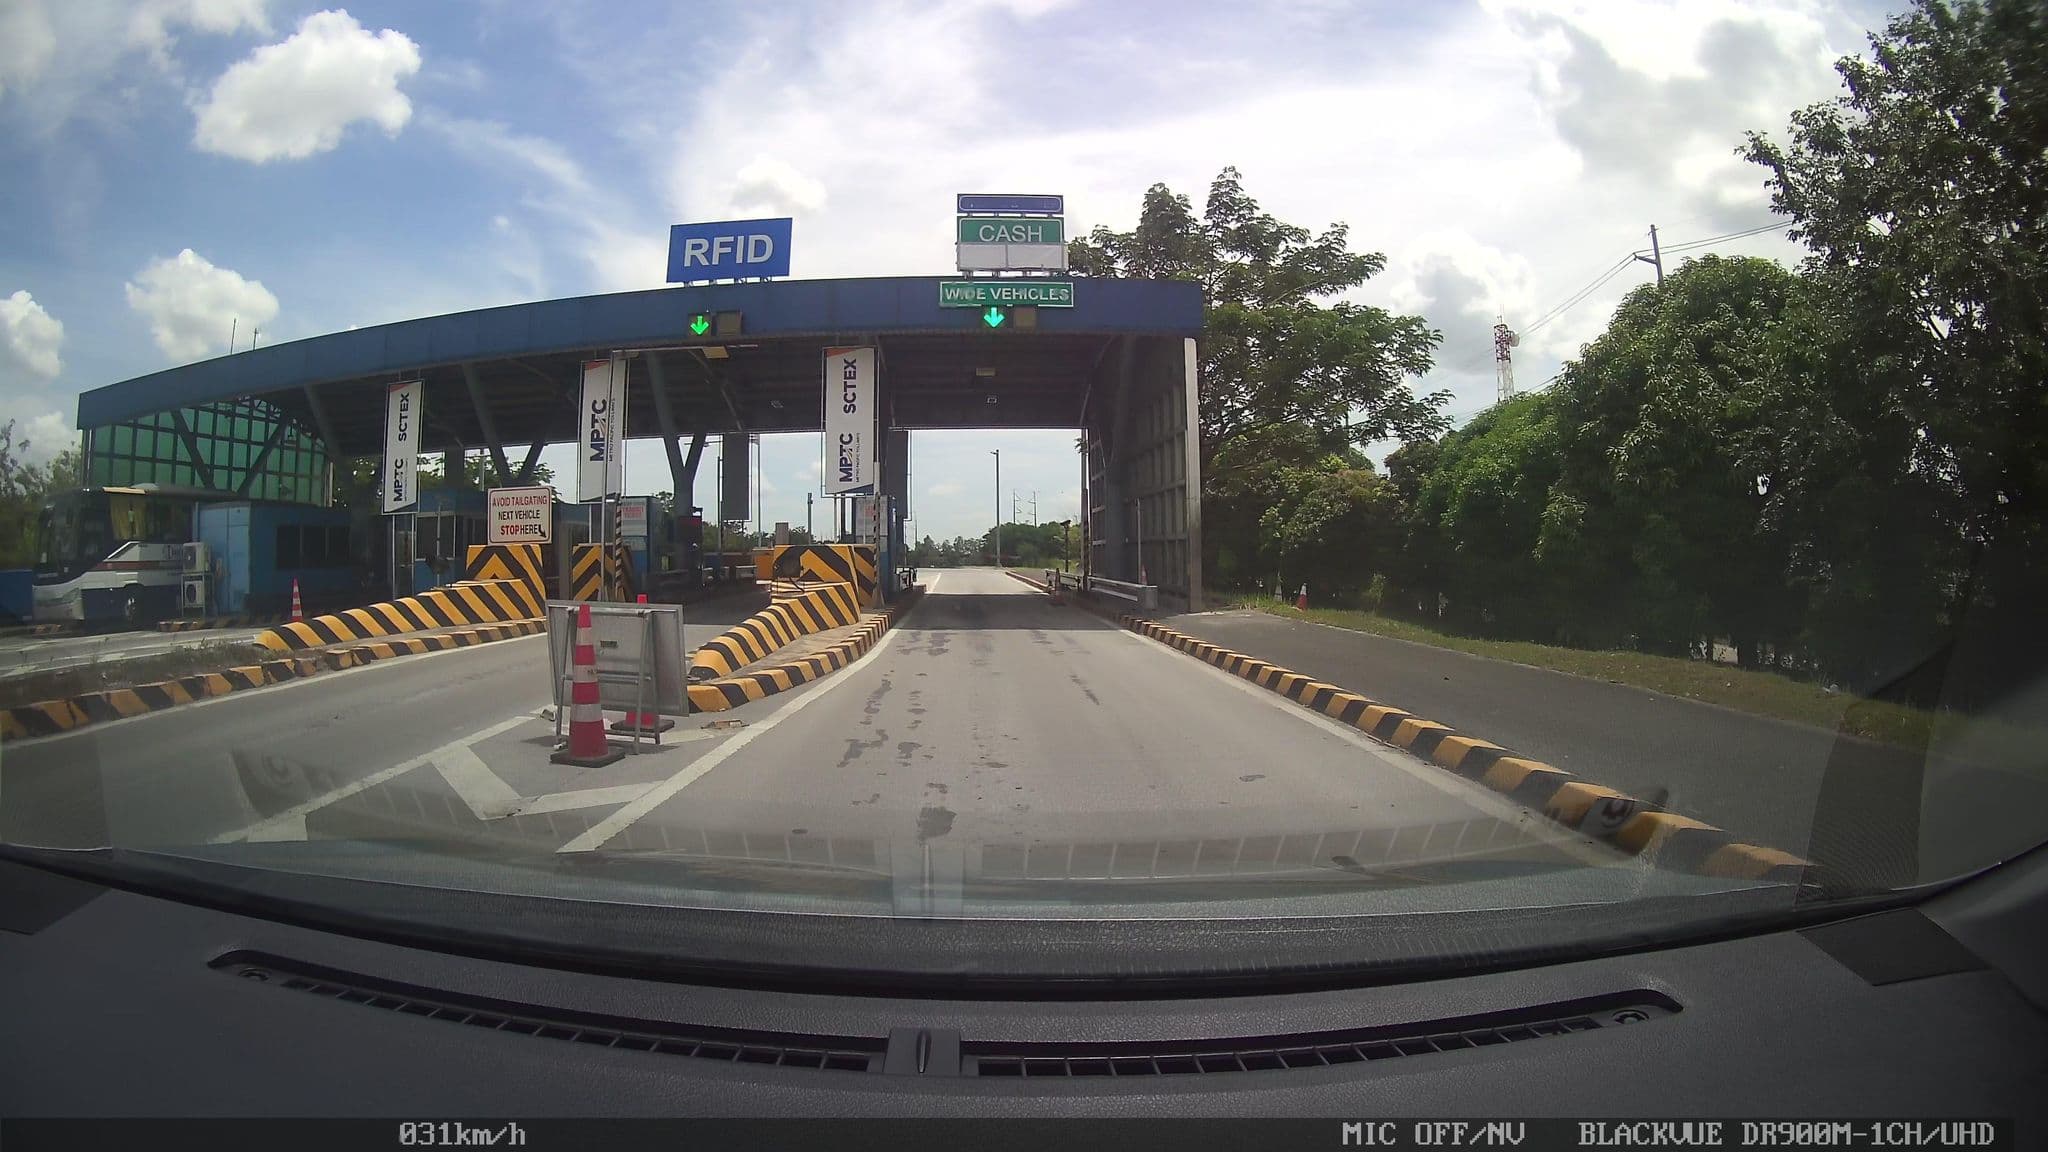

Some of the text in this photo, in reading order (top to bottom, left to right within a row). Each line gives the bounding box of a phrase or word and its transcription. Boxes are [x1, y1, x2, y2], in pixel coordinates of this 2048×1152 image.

[979, 225, 1043, 242] CASH
[683, 234, 774, 268] RFID
[990, 287, 1070, 302] VEHICLES
[843, 358, 856, 414] SCTEX
[398, 392, 409, 441] SCTEX
[590, 399, 607, 462] MPTC
[839, 433, 853, 482] MPTC
[393, 459, 404, 502] MPTC
[493, 496, 547, 507] AVOID TAILGATING
[498, 510, 540, 520] NEXT VEHICLE
[501, 524, 538, 535] STOP HERE
